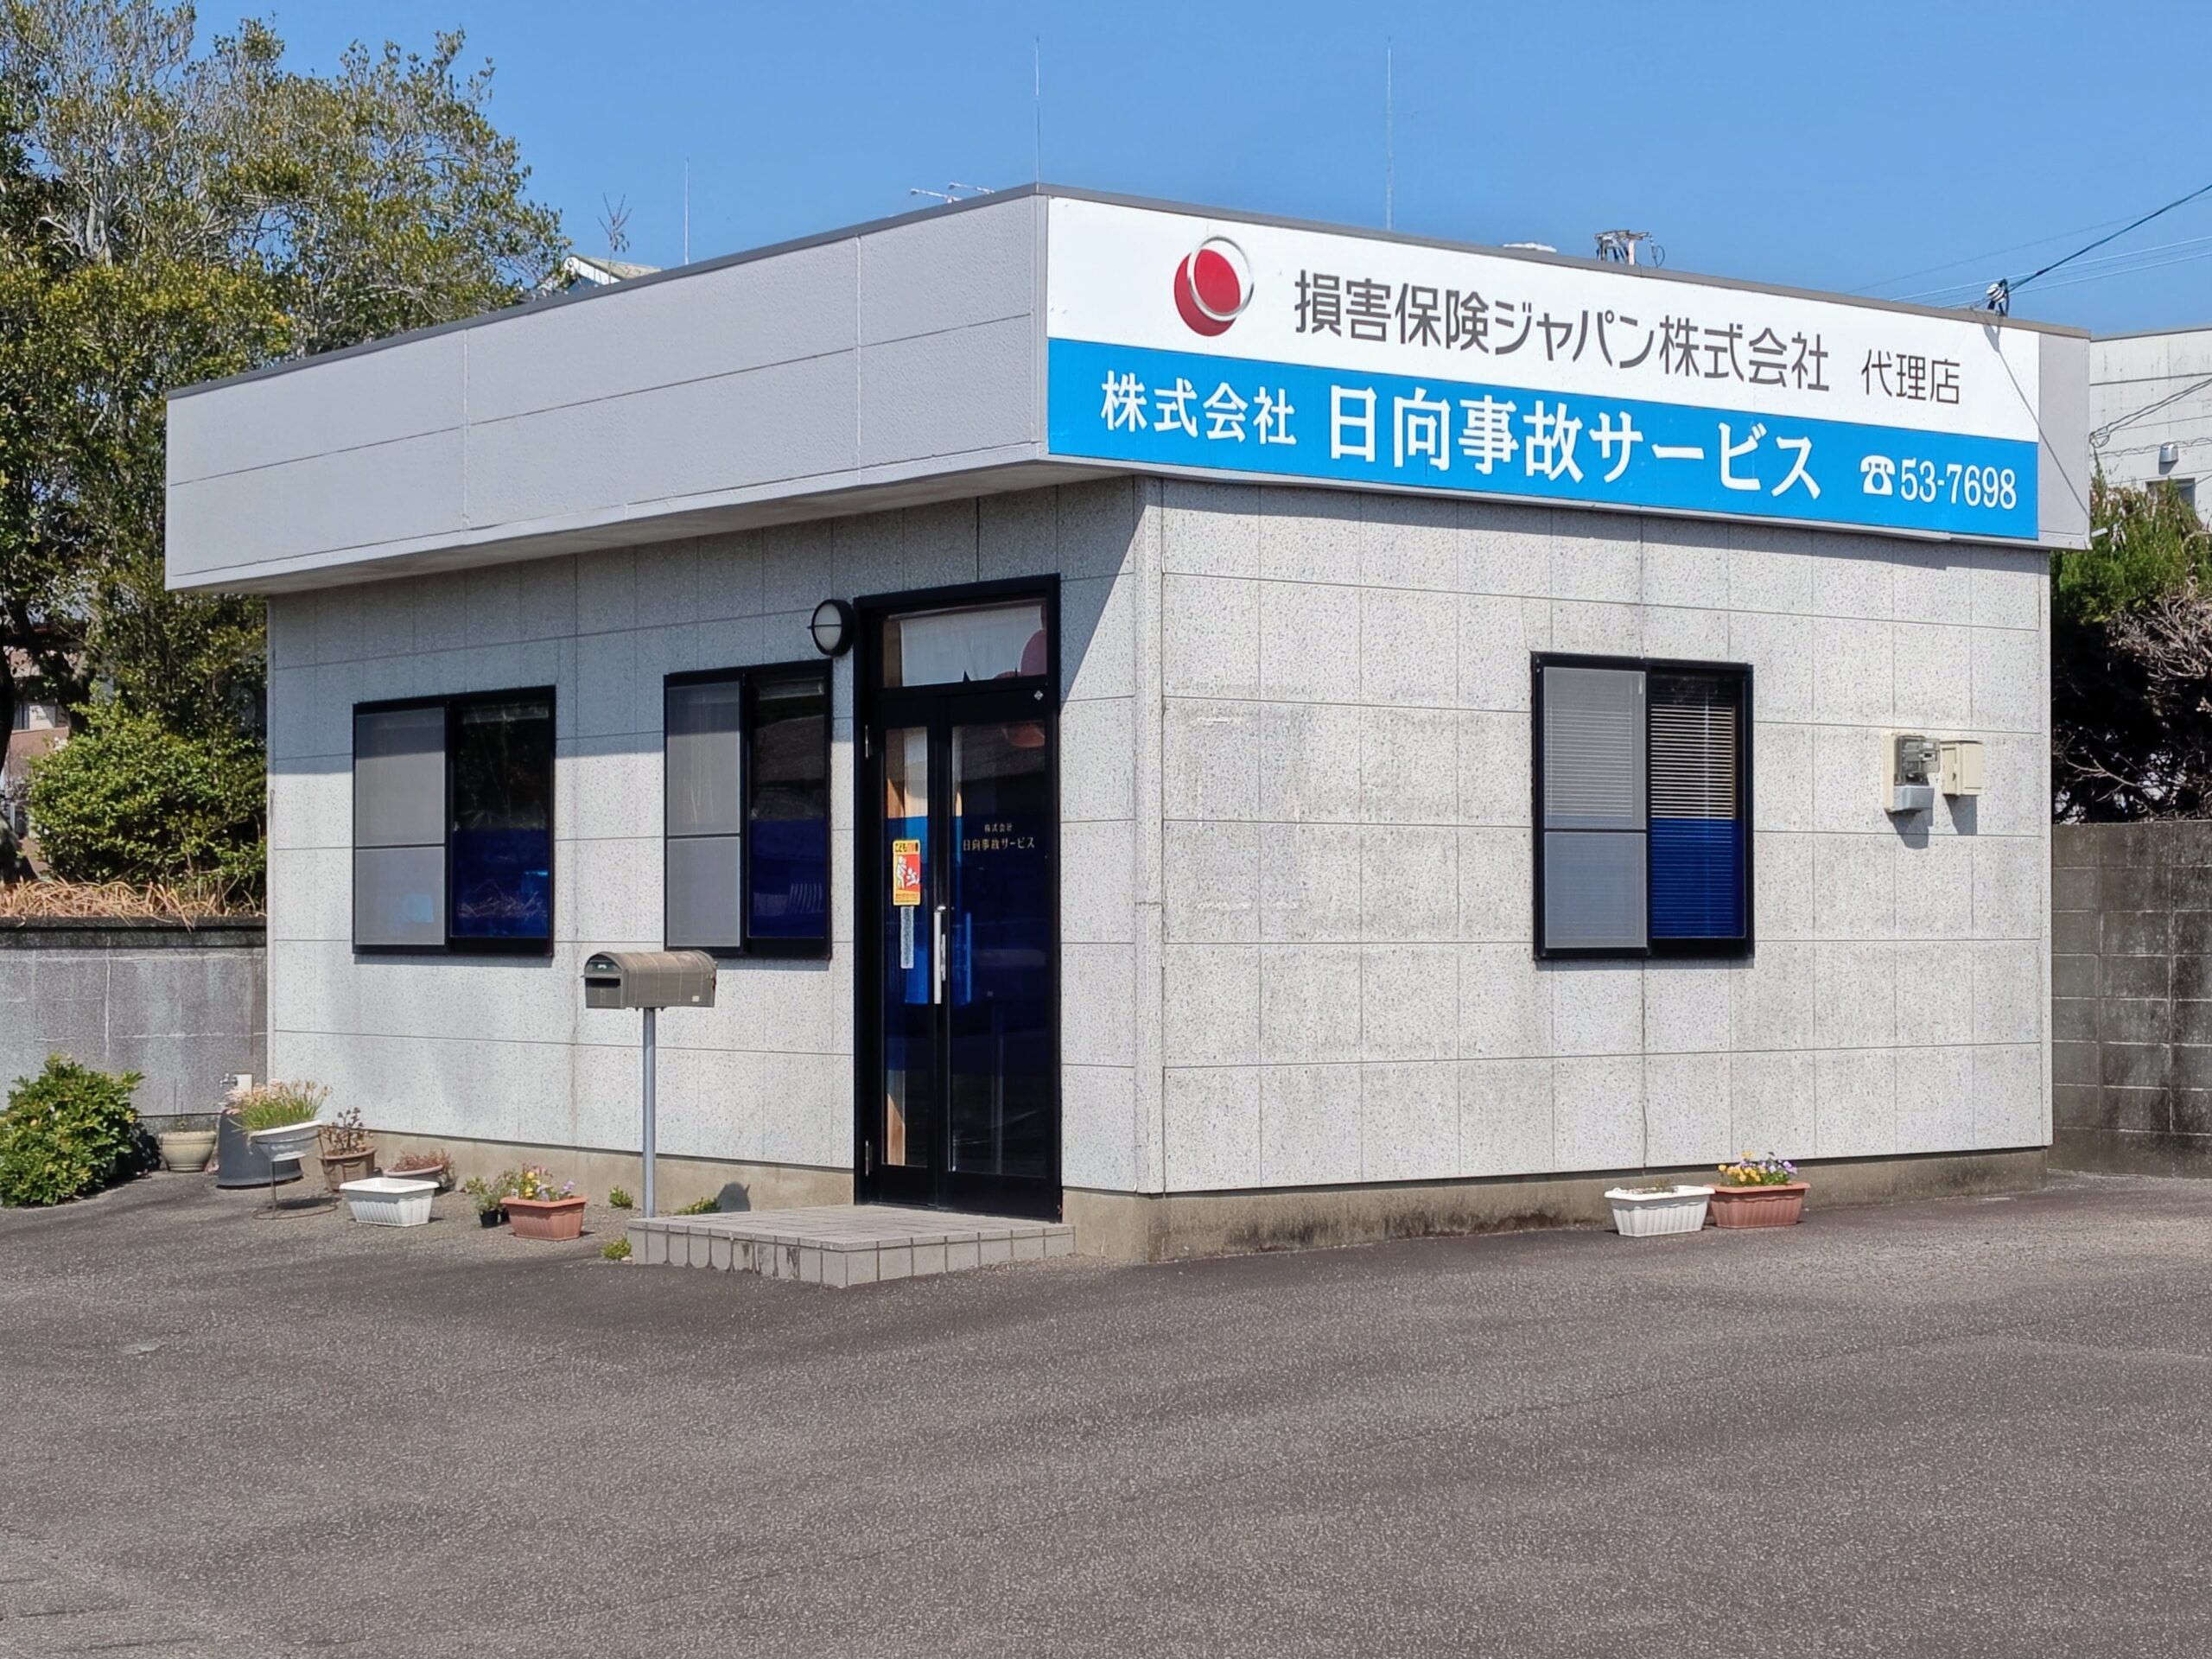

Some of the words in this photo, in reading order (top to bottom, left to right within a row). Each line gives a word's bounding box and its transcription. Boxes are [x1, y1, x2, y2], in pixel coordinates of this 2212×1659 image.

[1295, 269, 1829, 391] 損害保険ジャパン株式会社
[1861, 348, 1961, 404] 代理店
[1101, 370, 1297, 446] 株式会社
[1331, 385, 1821, 500] 日向事故サービス
[1900, 457, 2018, 510] 53-7698
[963, 837, 1035, 851] 日向事故サービス
